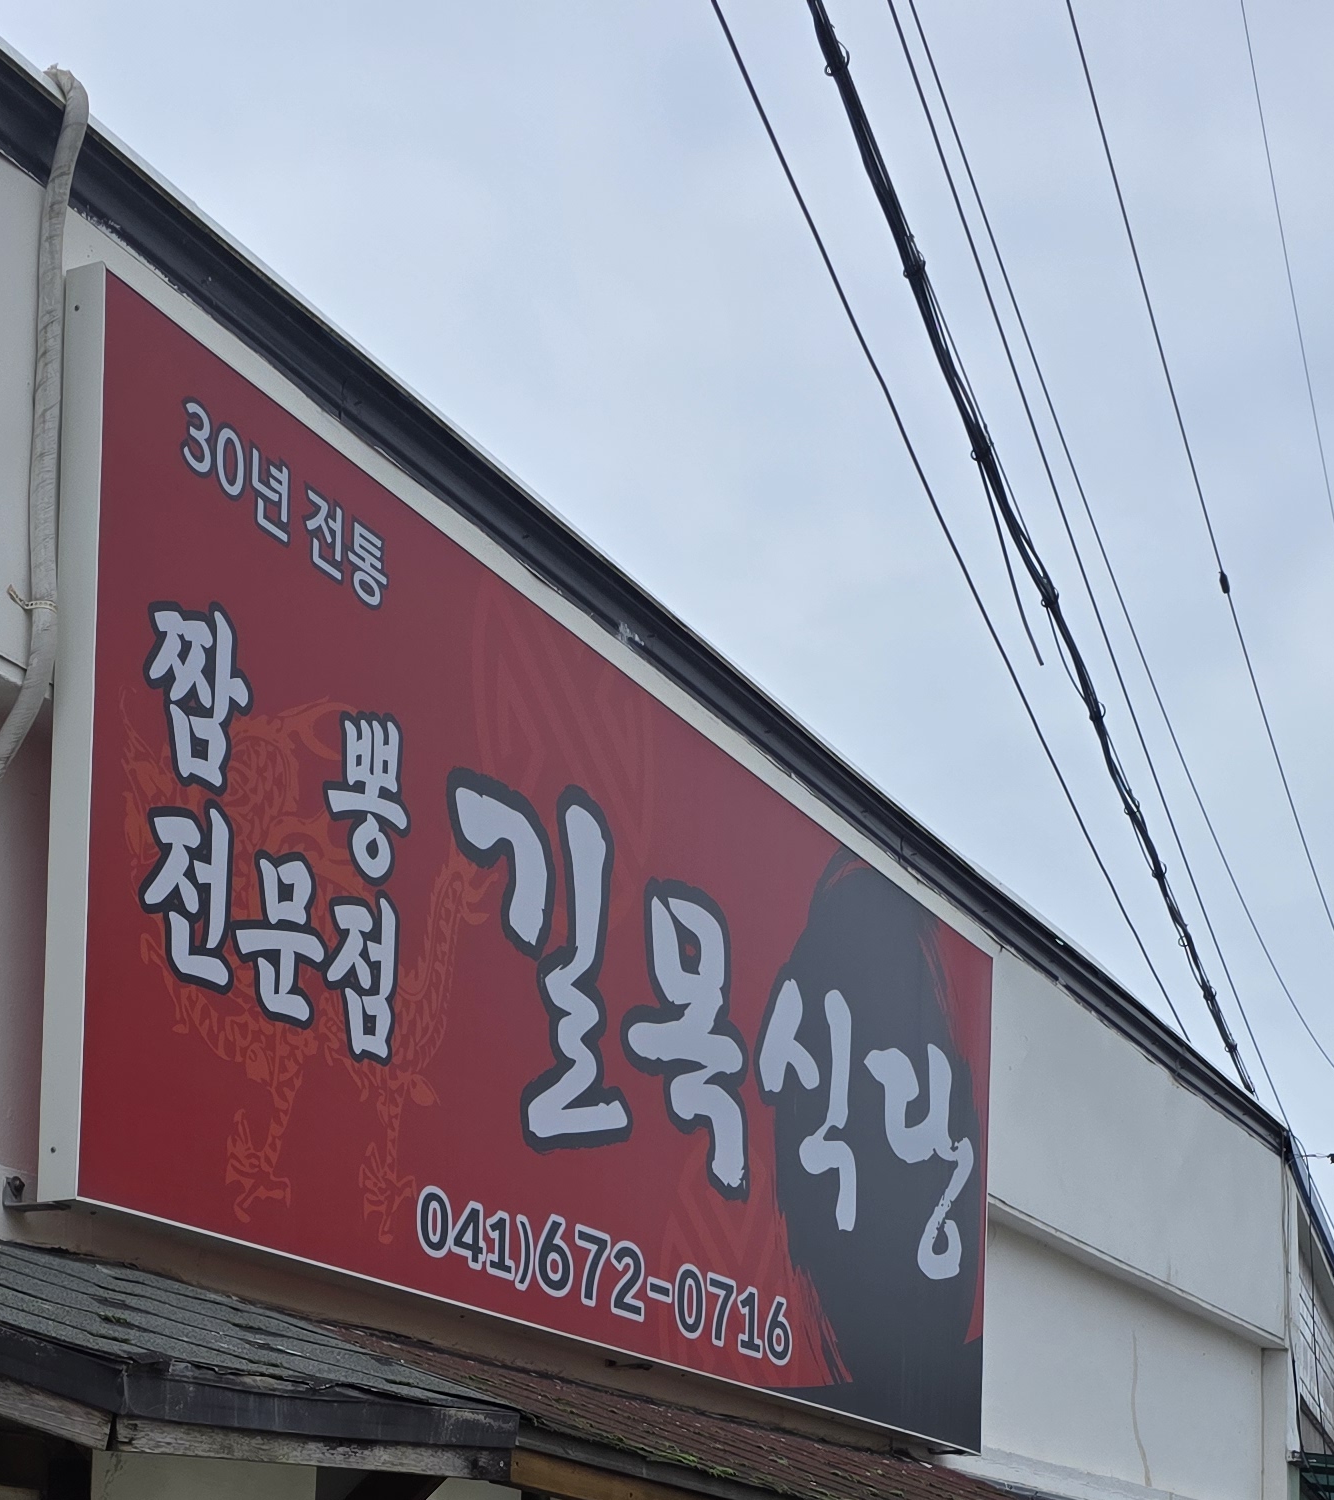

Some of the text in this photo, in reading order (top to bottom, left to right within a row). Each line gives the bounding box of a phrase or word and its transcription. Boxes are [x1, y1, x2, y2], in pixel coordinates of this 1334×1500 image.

[182, 400, 389, 611] 30년 전통
[143, 801, 402, 1068] 전문점
[446, 765, 975, 1280] 길목식당
[415, 1185, 793, 1365] 041)672-0716
